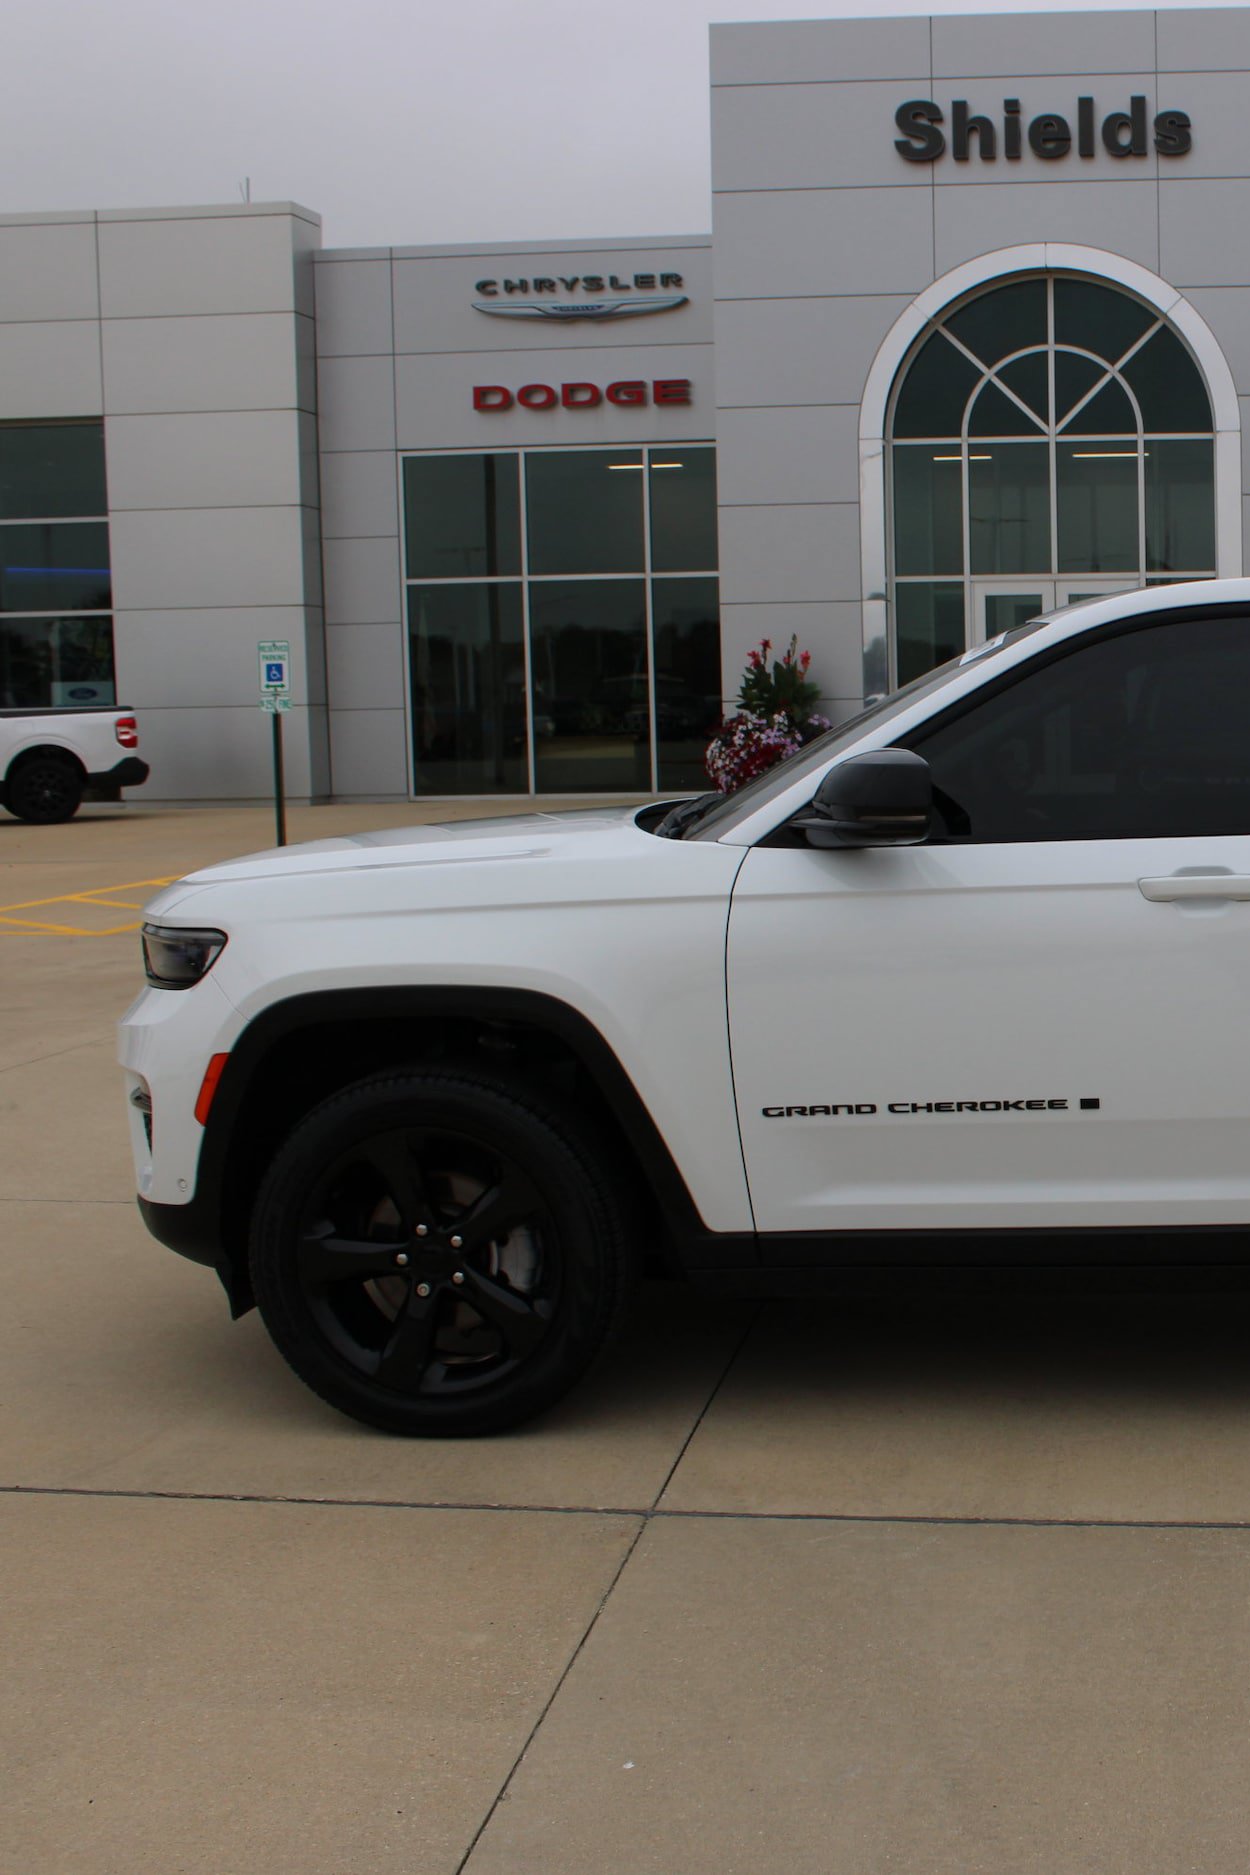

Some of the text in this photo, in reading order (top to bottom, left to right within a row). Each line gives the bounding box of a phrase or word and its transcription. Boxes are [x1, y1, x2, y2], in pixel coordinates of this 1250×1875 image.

[894, 95, 1193, 161] Shields
[475, 273, 684, 296] CHRYSLER
[473, 379, 692, 411] DODGE
[762, 1099, 1069, 1118] GRAND CHEROKEE
